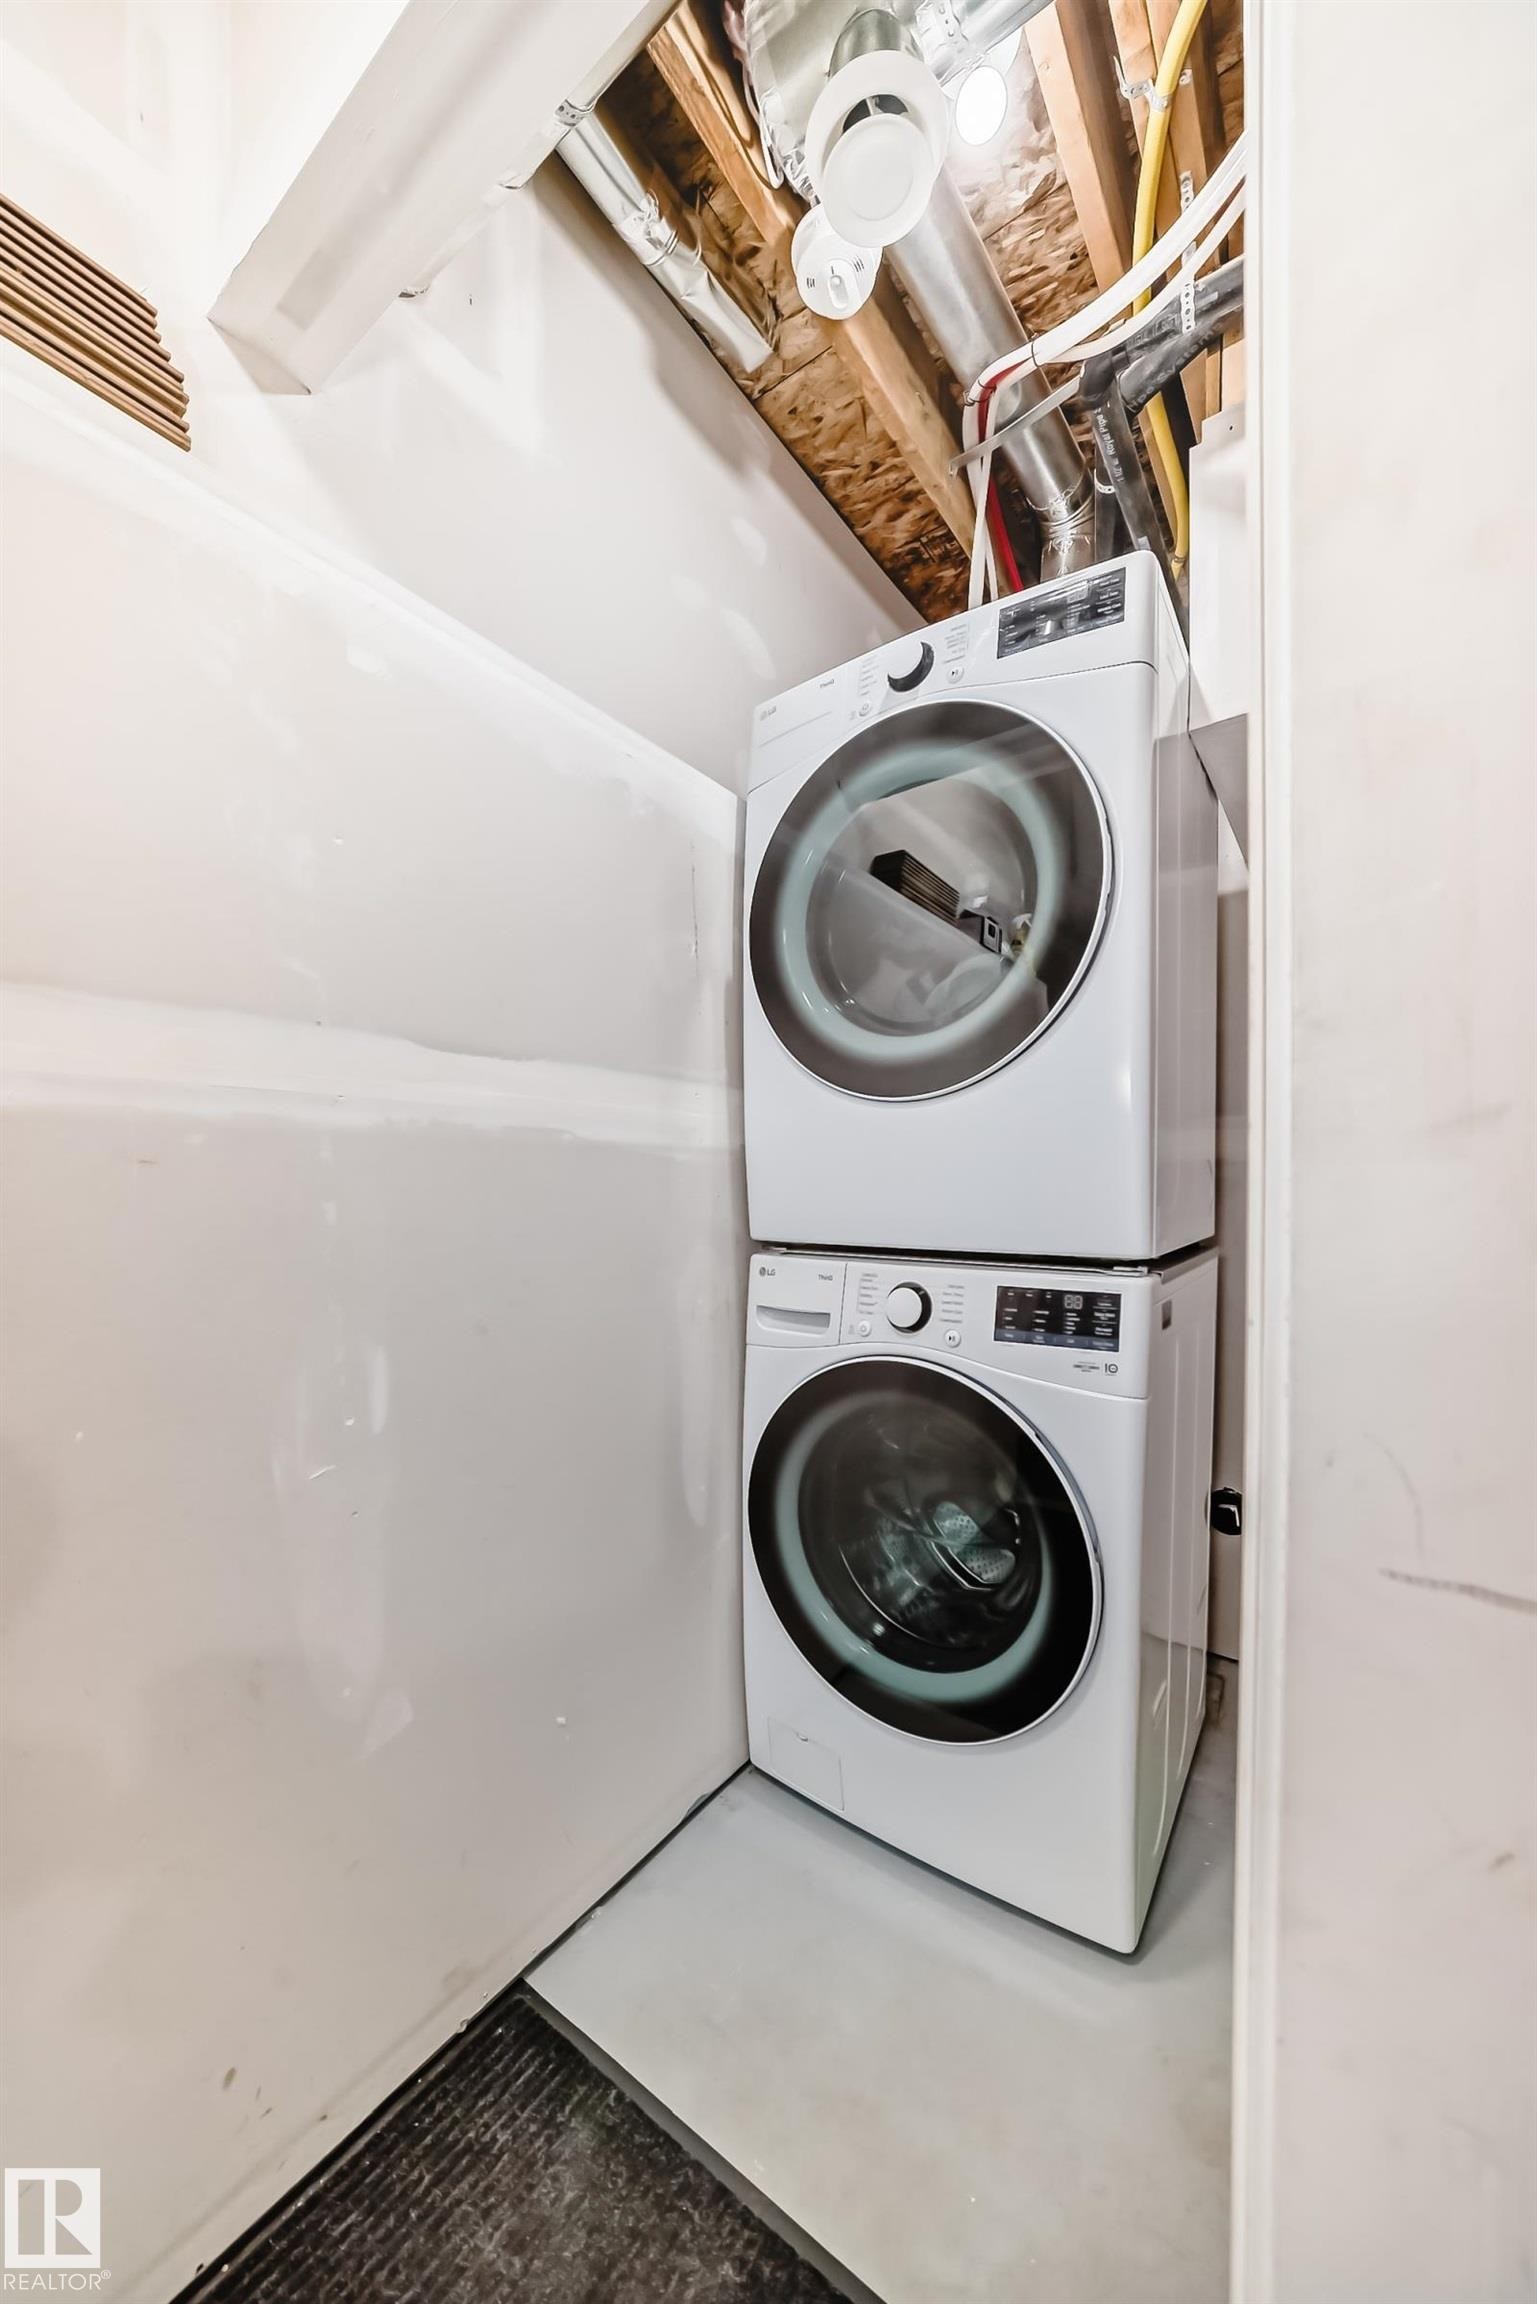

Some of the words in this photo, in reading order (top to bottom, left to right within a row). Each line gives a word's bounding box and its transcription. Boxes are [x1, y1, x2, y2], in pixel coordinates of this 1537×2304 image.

[1096, 414, 1109, 433] Pipe
[1102, 432, 1116, 457] Royal
[766, 1267, 776, 1277] LG
